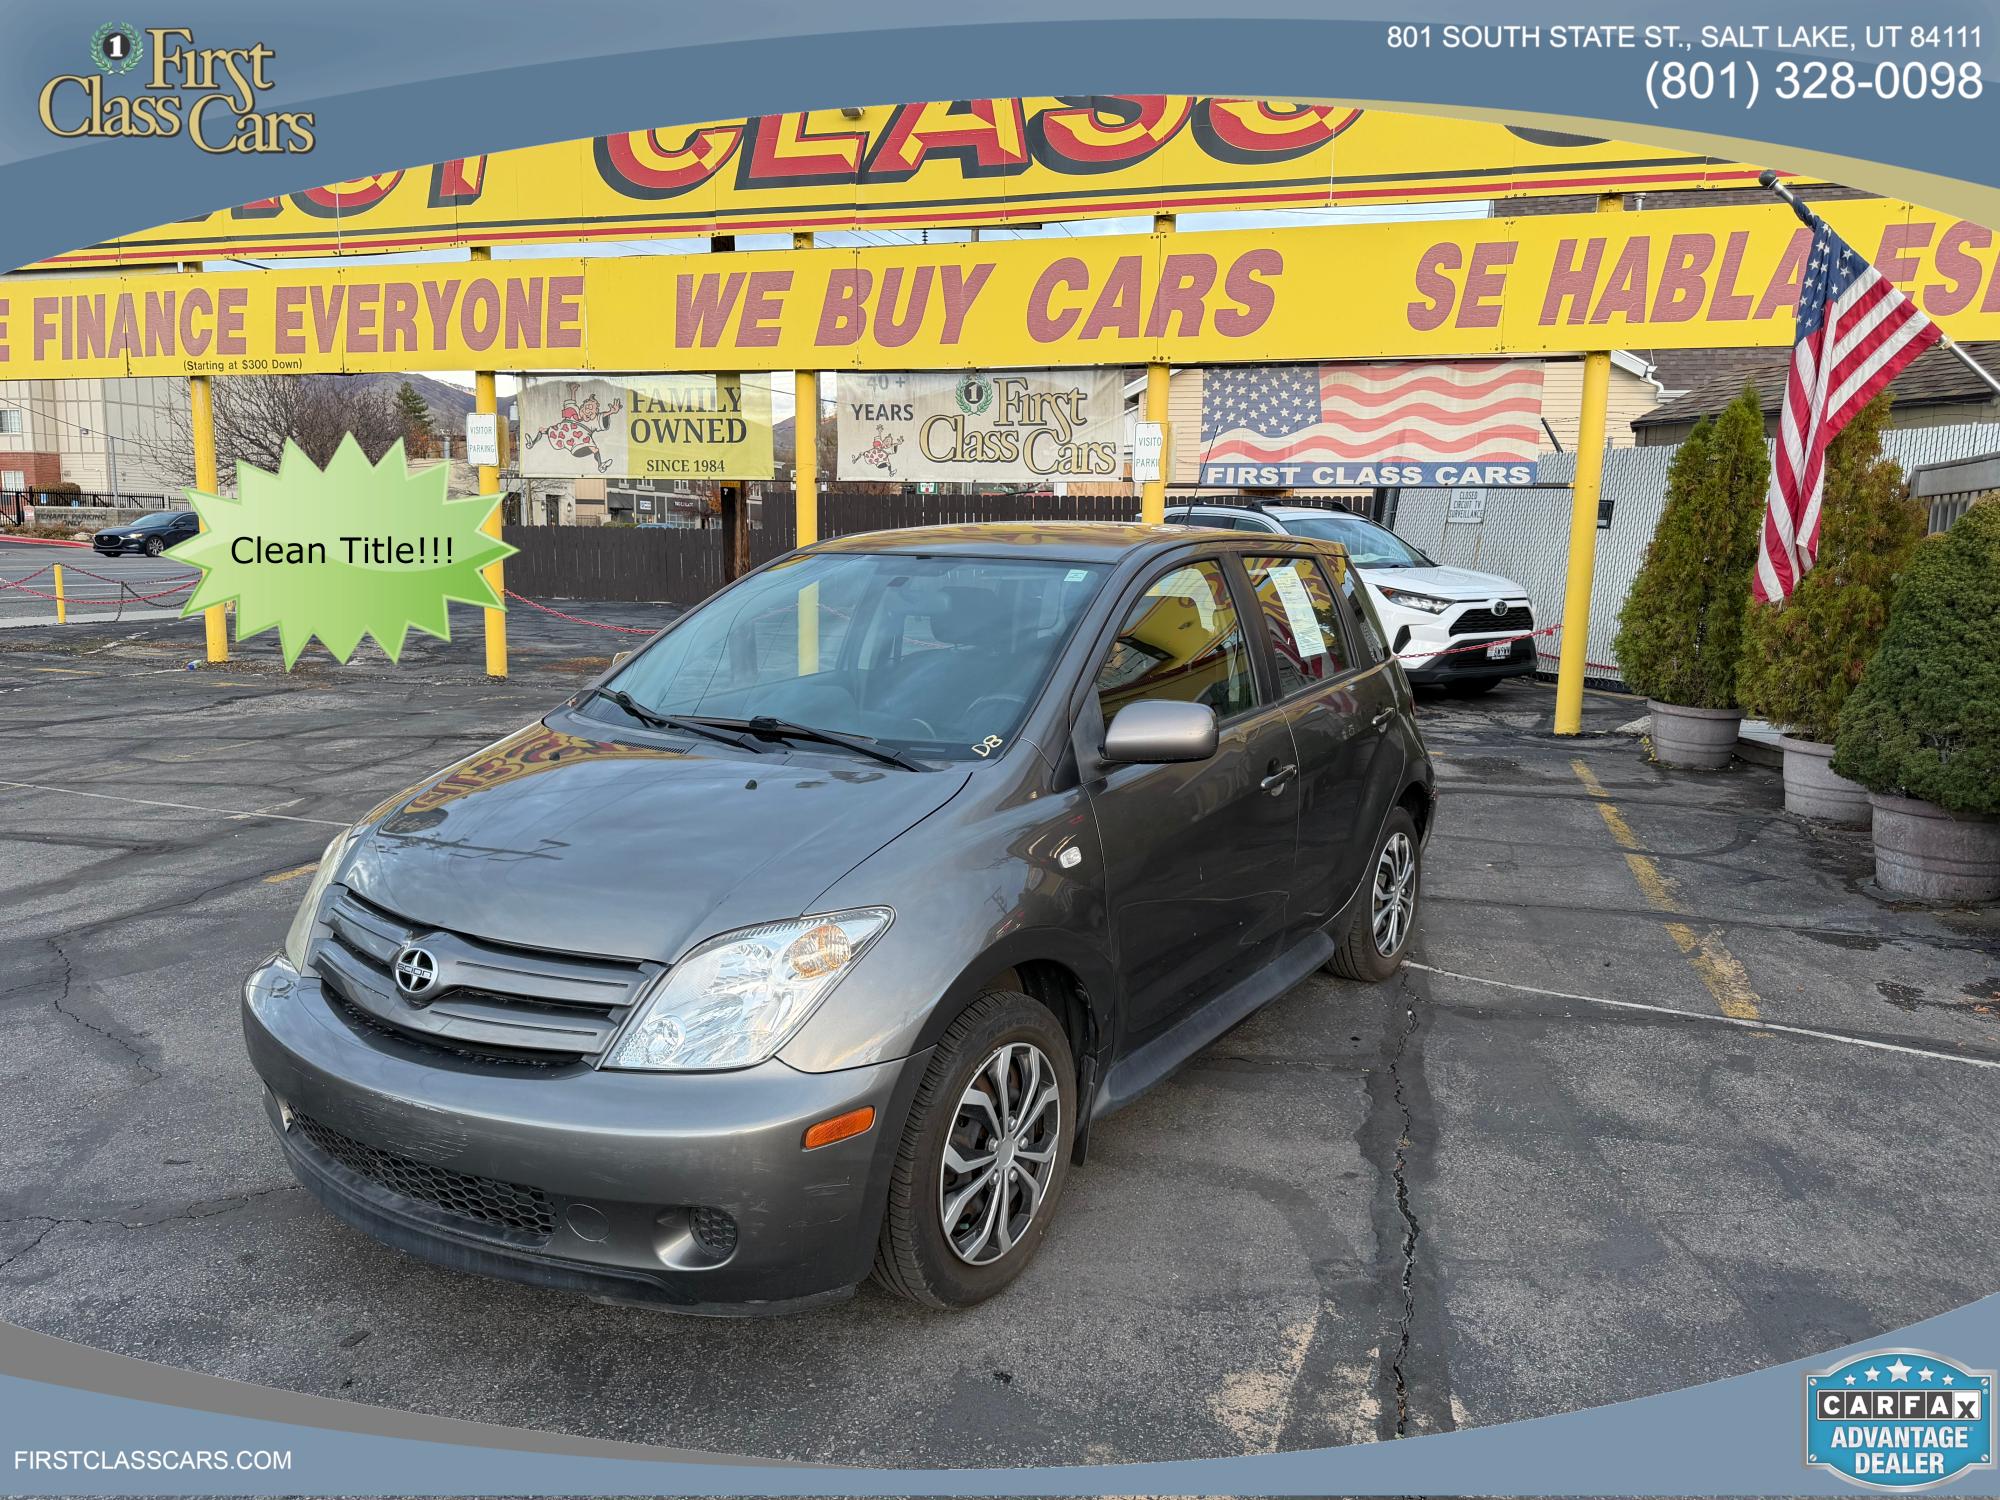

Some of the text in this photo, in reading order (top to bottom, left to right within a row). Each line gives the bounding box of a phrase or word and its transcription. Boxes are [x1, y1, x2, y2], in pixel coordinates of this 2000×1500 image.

[1406, 221, 2000, 331] SE HABLA ES
[674, 248, 1283, 348] WE BUY CARS
[34, 288, 248, 361] FINANCE
[275, 276, 584, 354] EVERYONE
[183, 358, 303, 372] (Starting at $300 Down)
[866, 375, 889, 390] 40
[630, 387, 743, 413] FAMILY
[993, 376, 1087, 444] First
[851, 403, 914, 421] YEARS
[470, 426, 493, 435] VISITOR
[630, 418, 747, 444] OWNED
[469, 444, 495, 453] PARKING
[919, 414, 1117, 475] Class Cars
[646, 459, 725, 472] SINCE 1984
[1207, 466, 1531, 485] FIRST CLASS CARS
